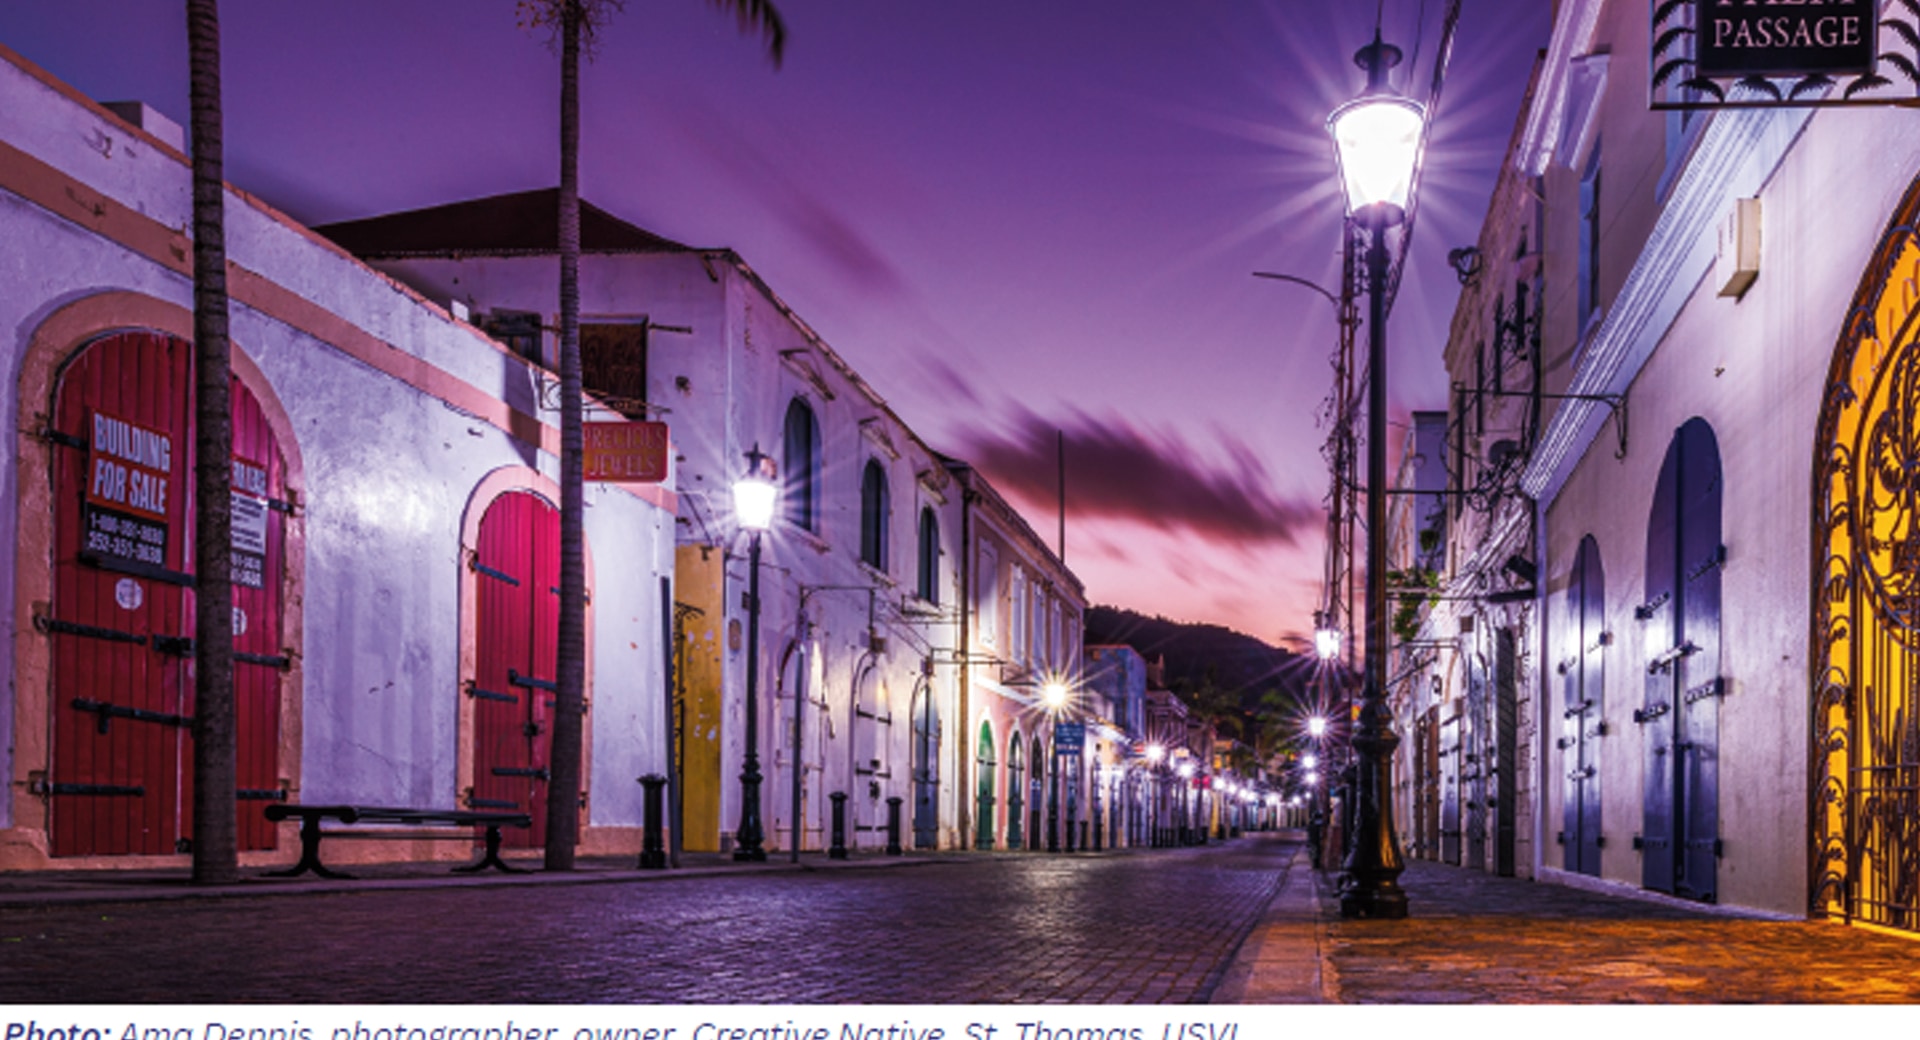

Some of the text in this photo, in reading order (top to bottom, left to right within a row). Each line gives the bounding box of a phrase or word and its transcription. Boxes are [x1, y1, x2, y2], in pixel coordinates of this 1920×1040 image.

[1713, 17, 1861, 48] PASSAGE
[94, 412, 171, 473] BUILDING
[93, 458, 167, 515] FOR SALE
[589, 455, 656, 476] JEWELS
